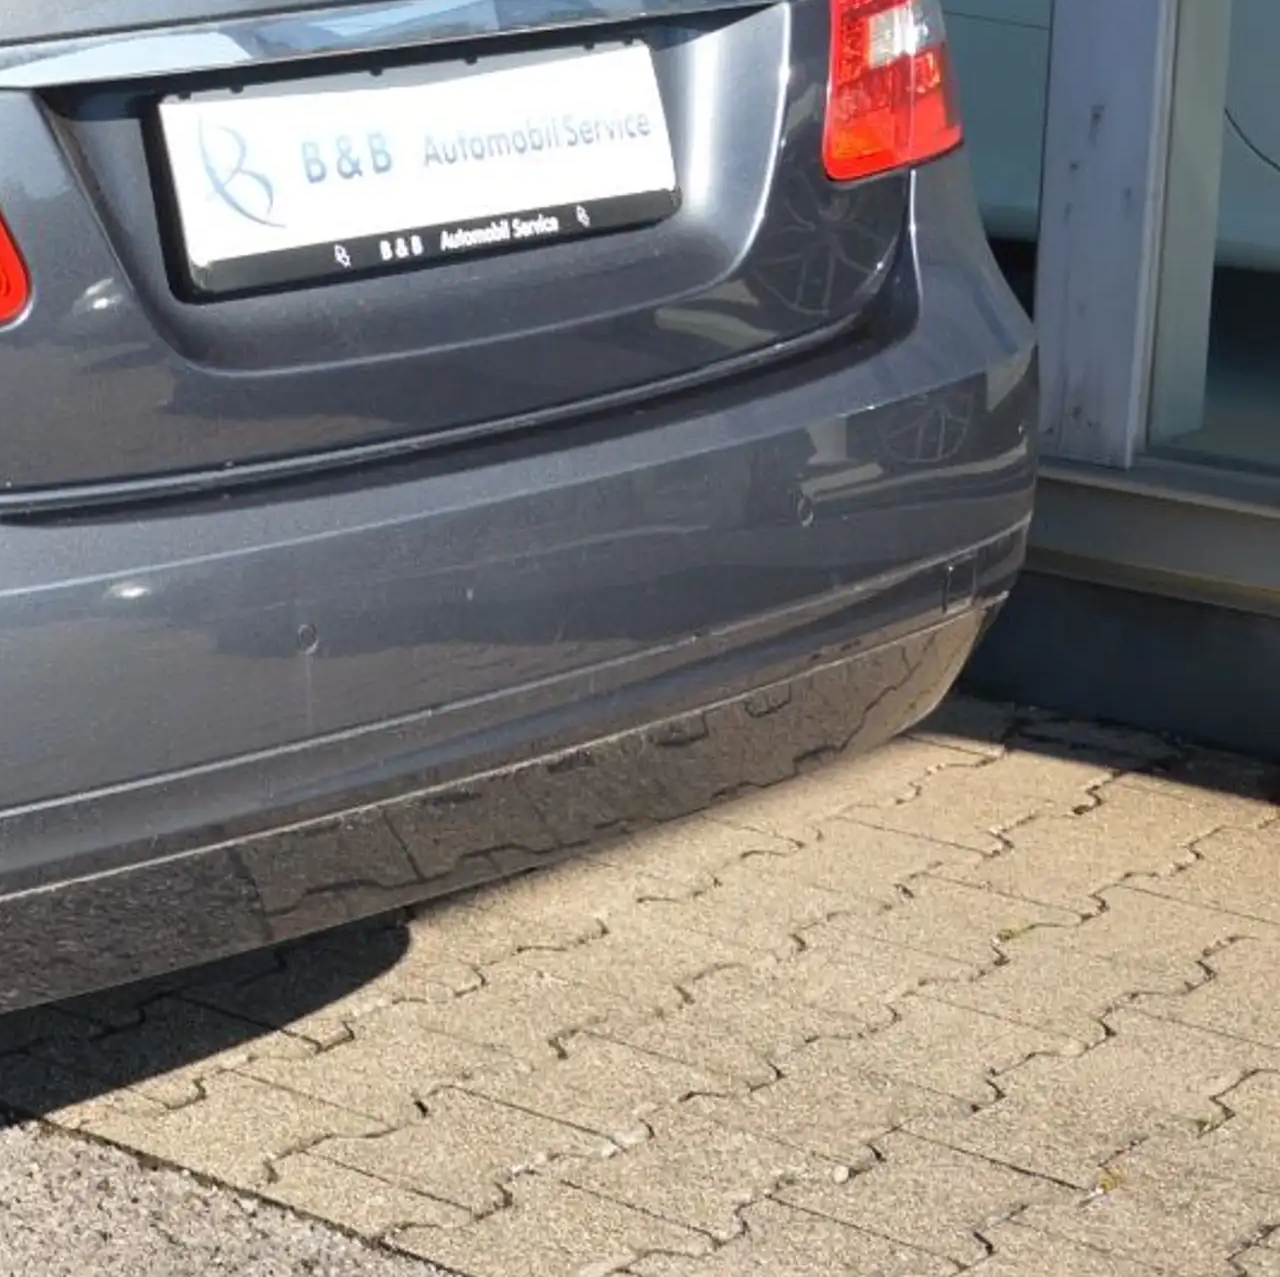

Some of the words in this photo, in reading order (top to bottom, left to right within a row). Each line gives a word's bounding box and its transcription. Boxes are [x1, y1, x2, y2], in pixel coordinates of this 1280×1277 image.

[301, 140, 327, 184] B
[335, 135, 363, 180] &
[367, 131, 393, 174] B
[379, 240, 393, 261] B
[410, 235, 424, 256] B
[440, 219, 511, 251] Automobil
[511, 213, 559, 238] Service
